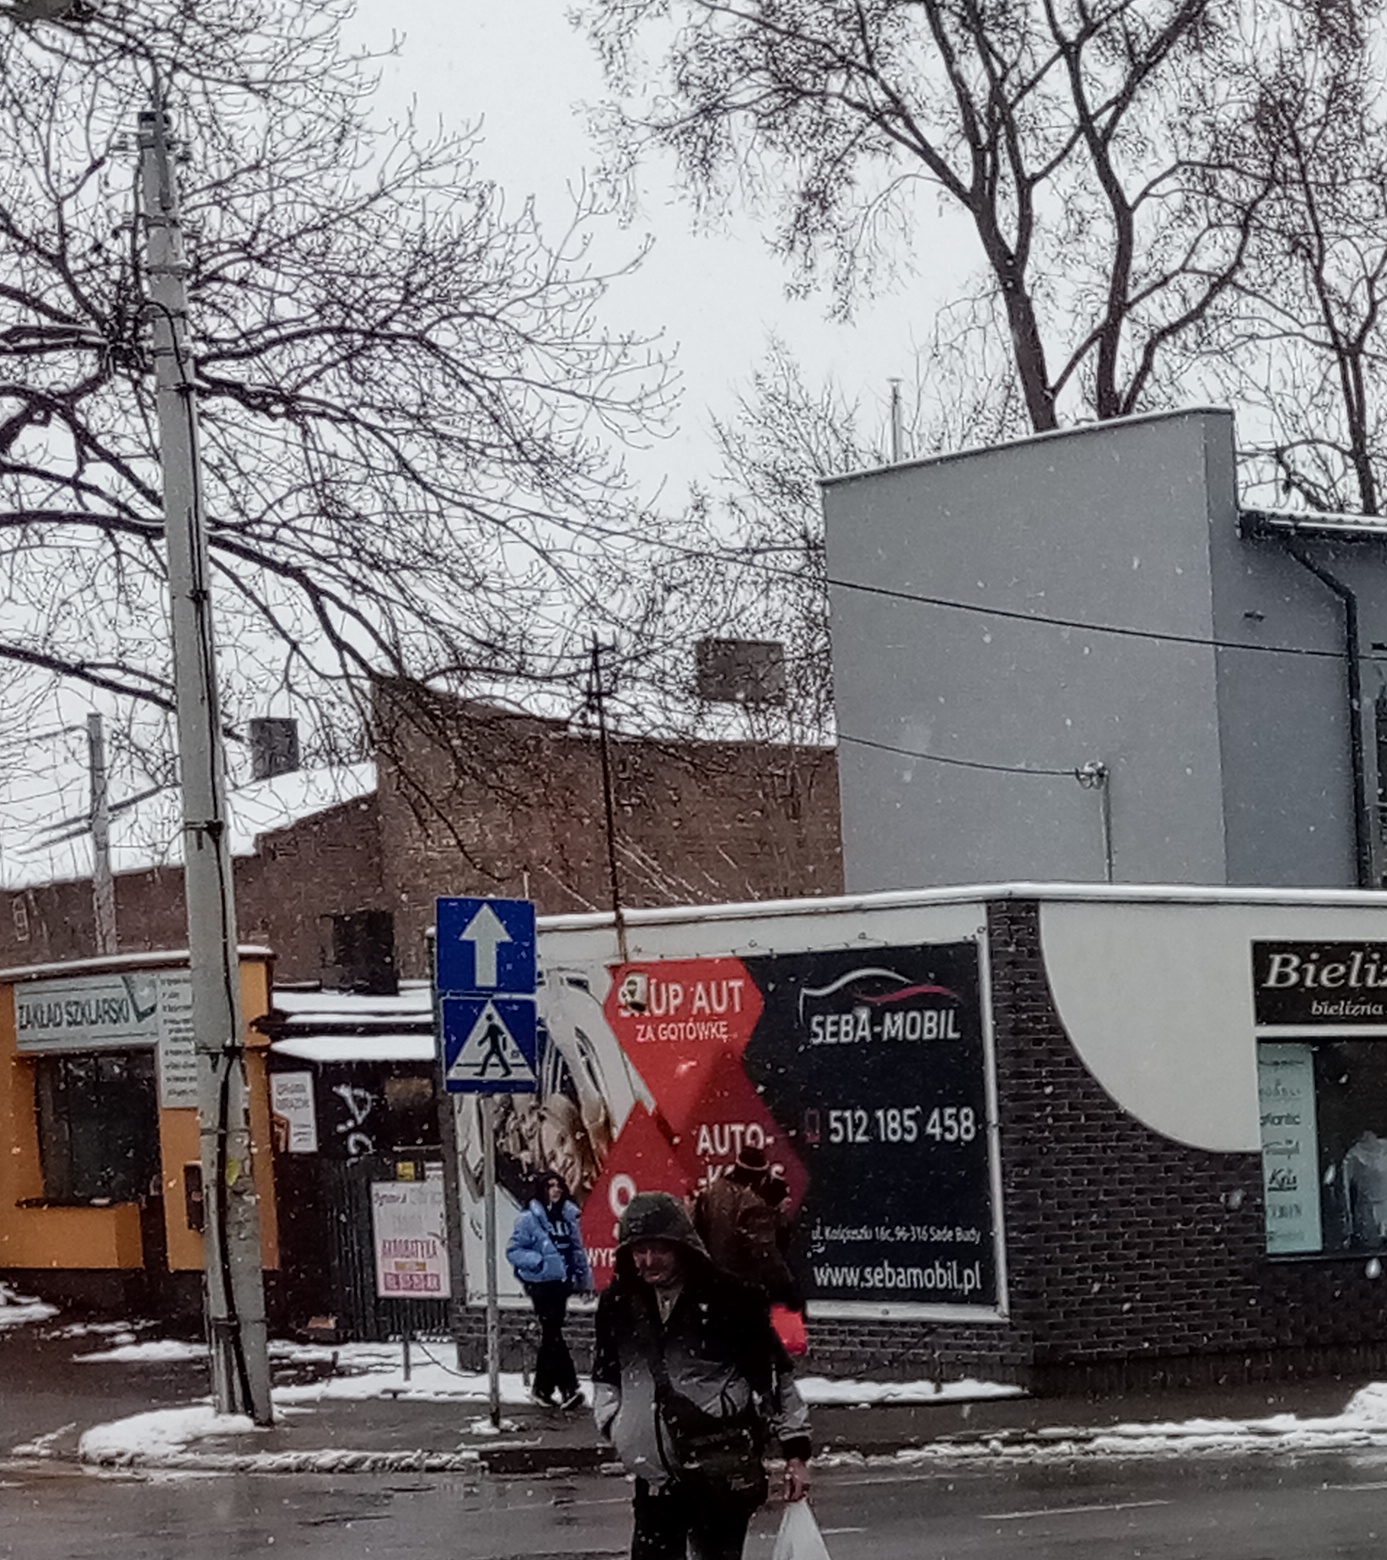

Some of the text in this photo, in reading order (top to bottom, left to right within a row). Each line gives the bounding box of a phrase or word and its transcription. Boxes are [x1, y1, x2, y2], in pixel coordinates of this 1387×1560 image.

[691, 978, 744, 1014] AUT
[635, 1018, 728, 1042] ZA GOTÓWKĘ
[811, 1010, 961, 1045] SEBA-MOBIL
[829, 1106, 977, 1143] 512 185 458
[813, 1259, 983, 1296] www.sebamobil.pl
